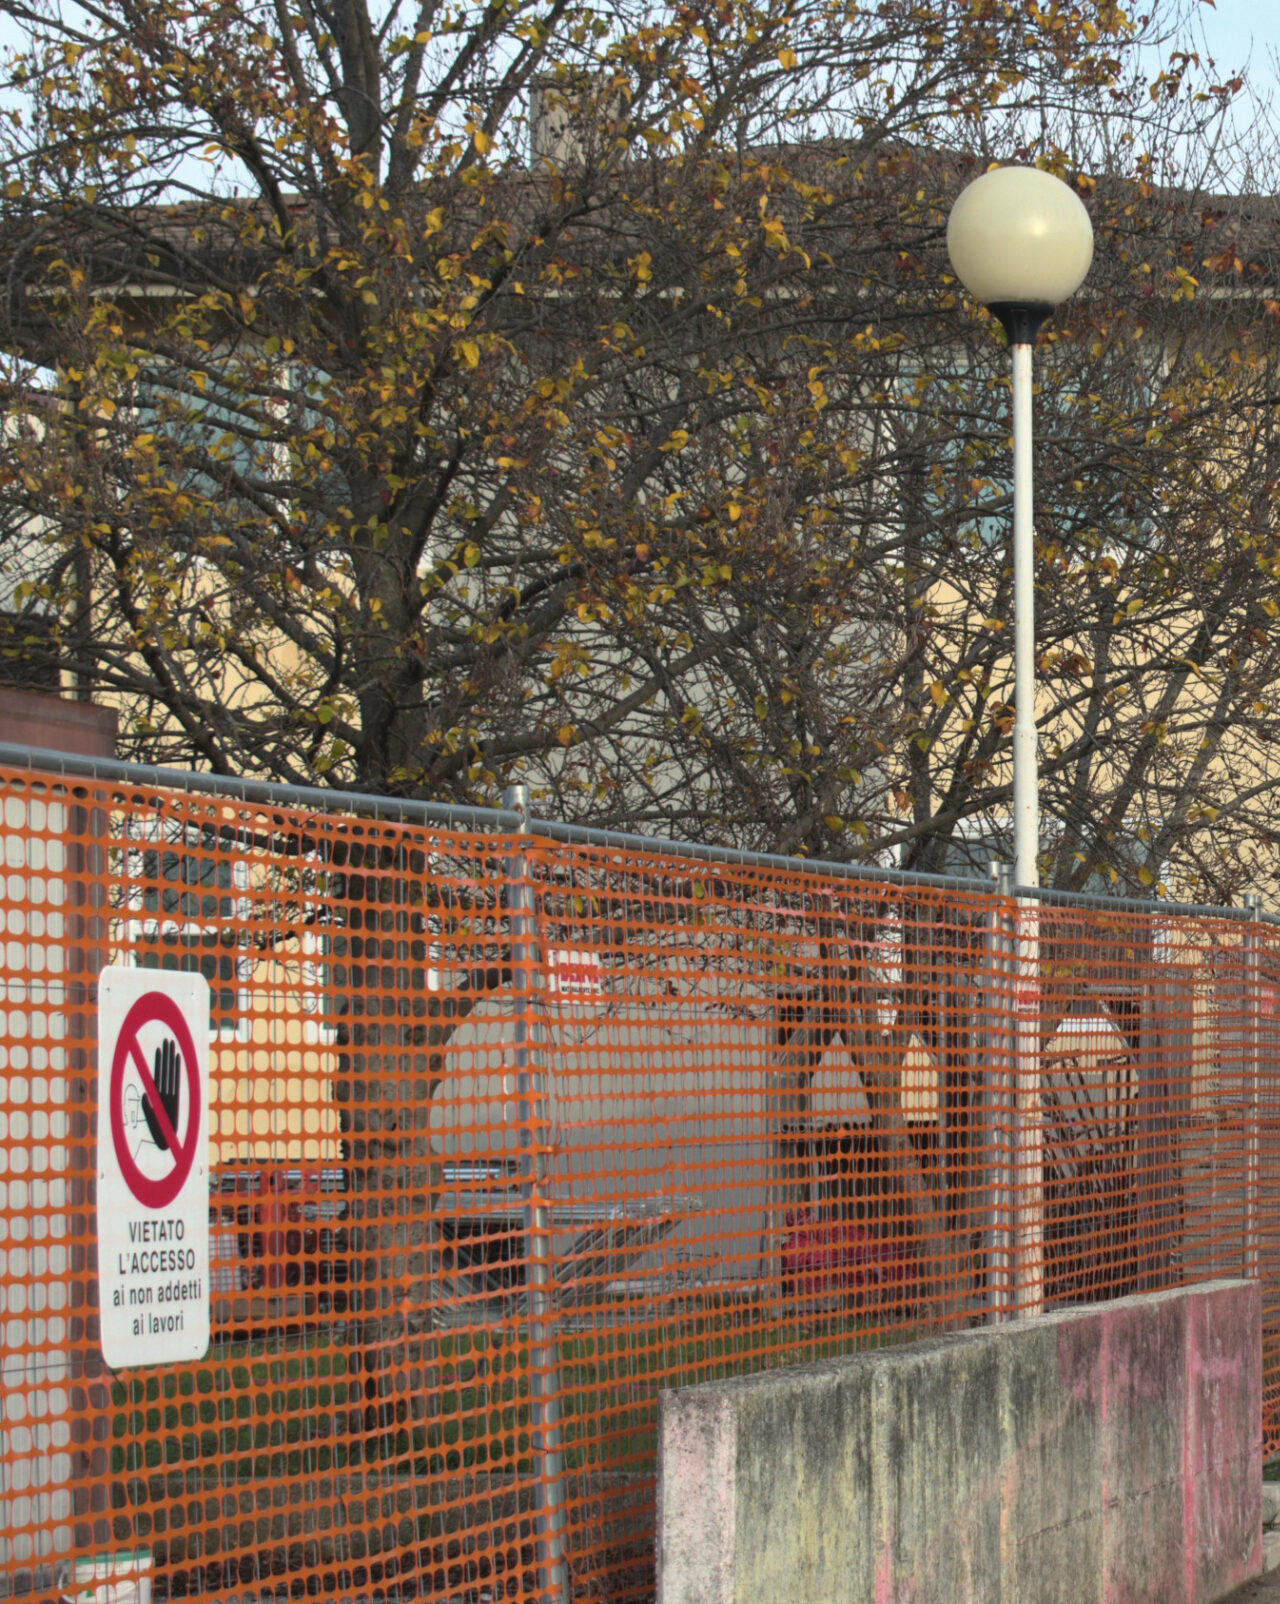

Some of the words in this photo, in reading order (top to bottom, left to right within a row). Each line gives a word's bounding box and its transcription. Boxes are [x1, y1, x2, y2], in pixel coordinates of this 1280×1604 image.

[129, 1219, 185, 1243] VIETATO
[119, 1248, 196, 1275] L'ACCESSO
[113, 1283, 125, 1307] ai
[129, 1287, 153, 1305] non
[157, 1278, 202, 1303] addetti
[133, 1313, 145, 1336] ai
[148, 1310, 184, 1335] lavori
